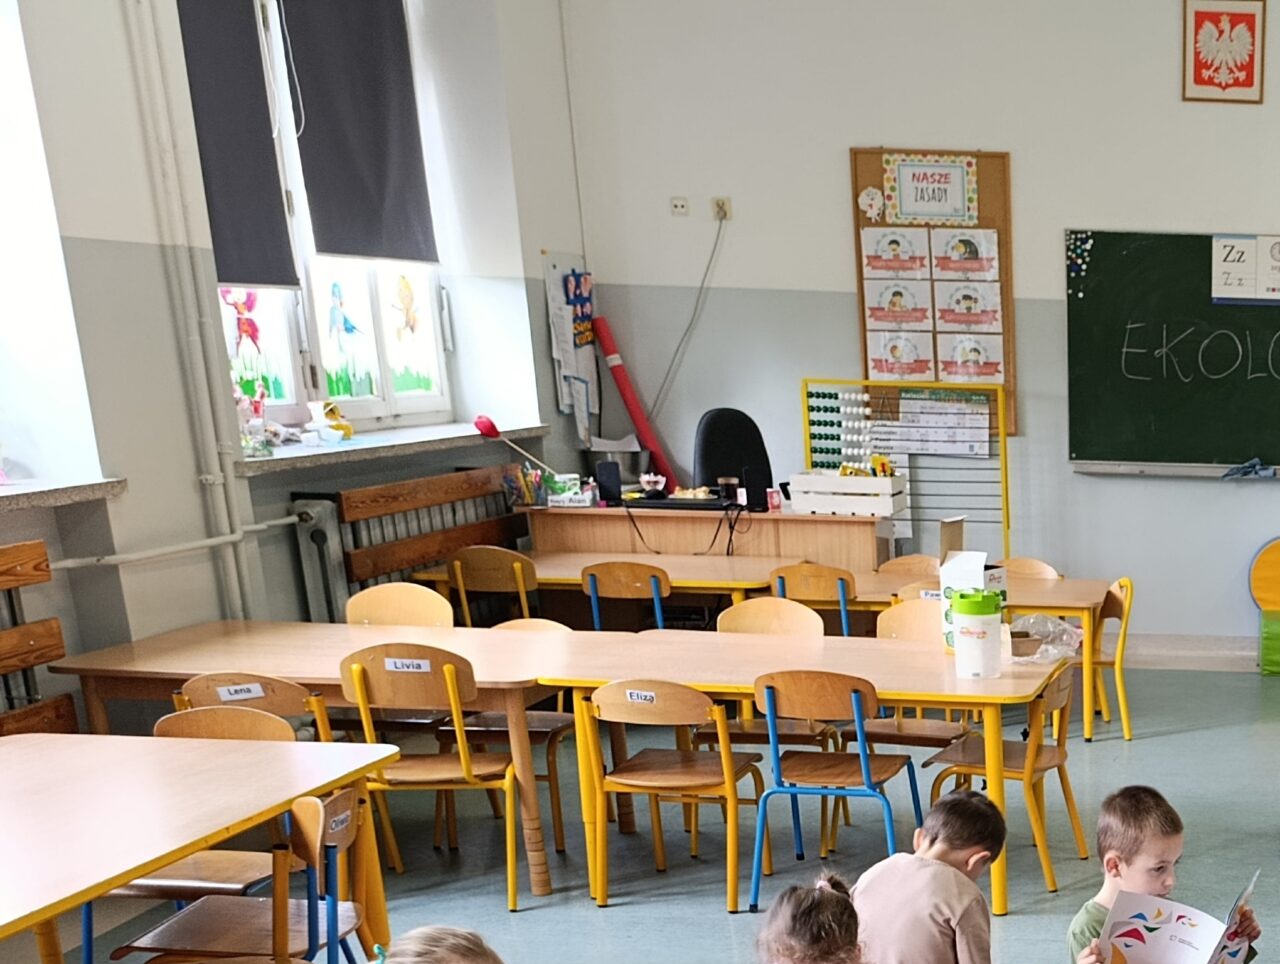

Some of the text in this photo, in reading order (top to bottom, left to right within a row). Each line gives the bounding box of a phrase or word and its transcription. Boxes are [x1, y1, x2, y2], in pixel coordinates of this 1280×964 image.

[912, 172, 951, 184] NASZE
[914, 186, 948, 203] ZASADY
[1222, 244, 1246, 264] Zz
[393, 660, 422, 671] Livia
[226, 687, 252, 696] Lena
